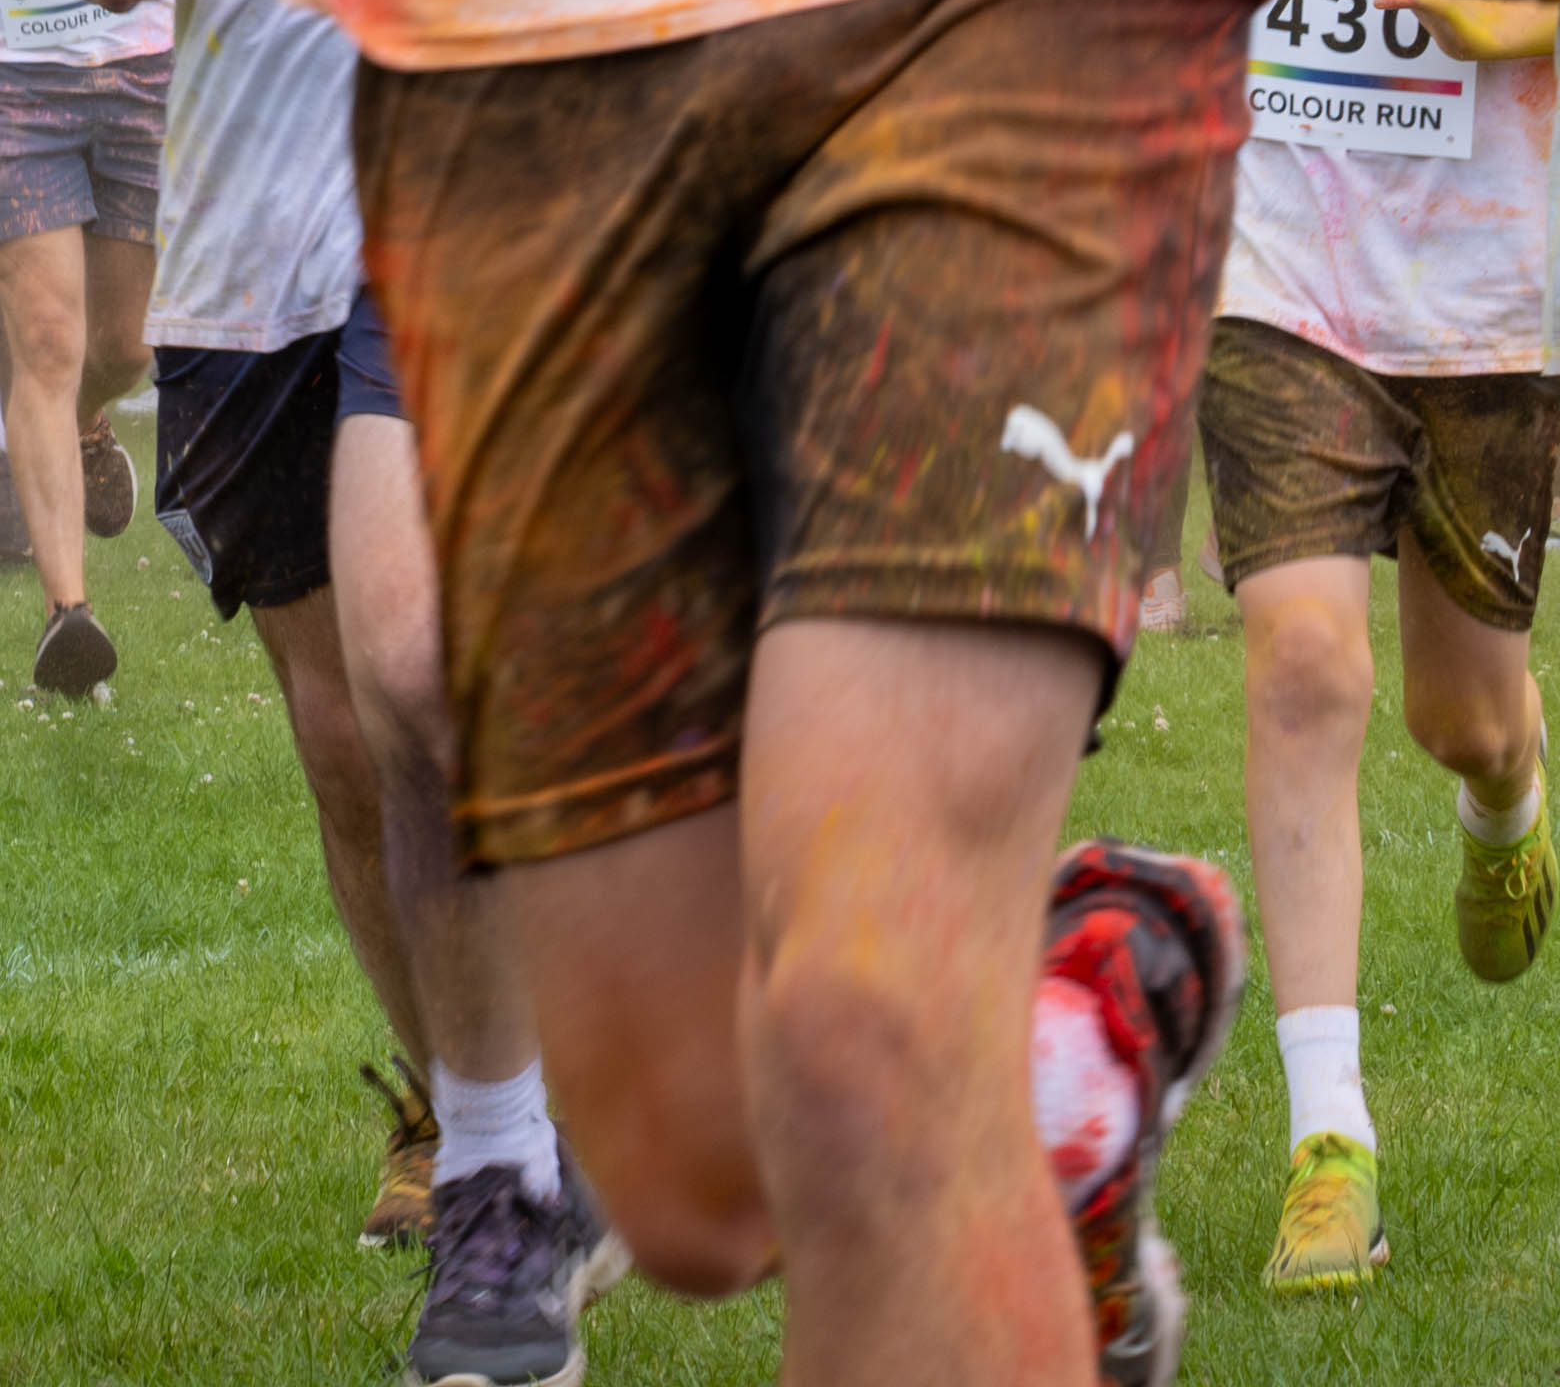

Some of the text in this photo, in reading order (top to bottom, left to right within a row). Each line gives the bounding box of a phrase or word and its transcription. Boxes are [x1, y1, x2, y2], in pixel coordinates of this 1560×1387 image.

[20, 12, 89, 35] COLOUR
[1250, 87, 1442, 131] COLOUR RUN
